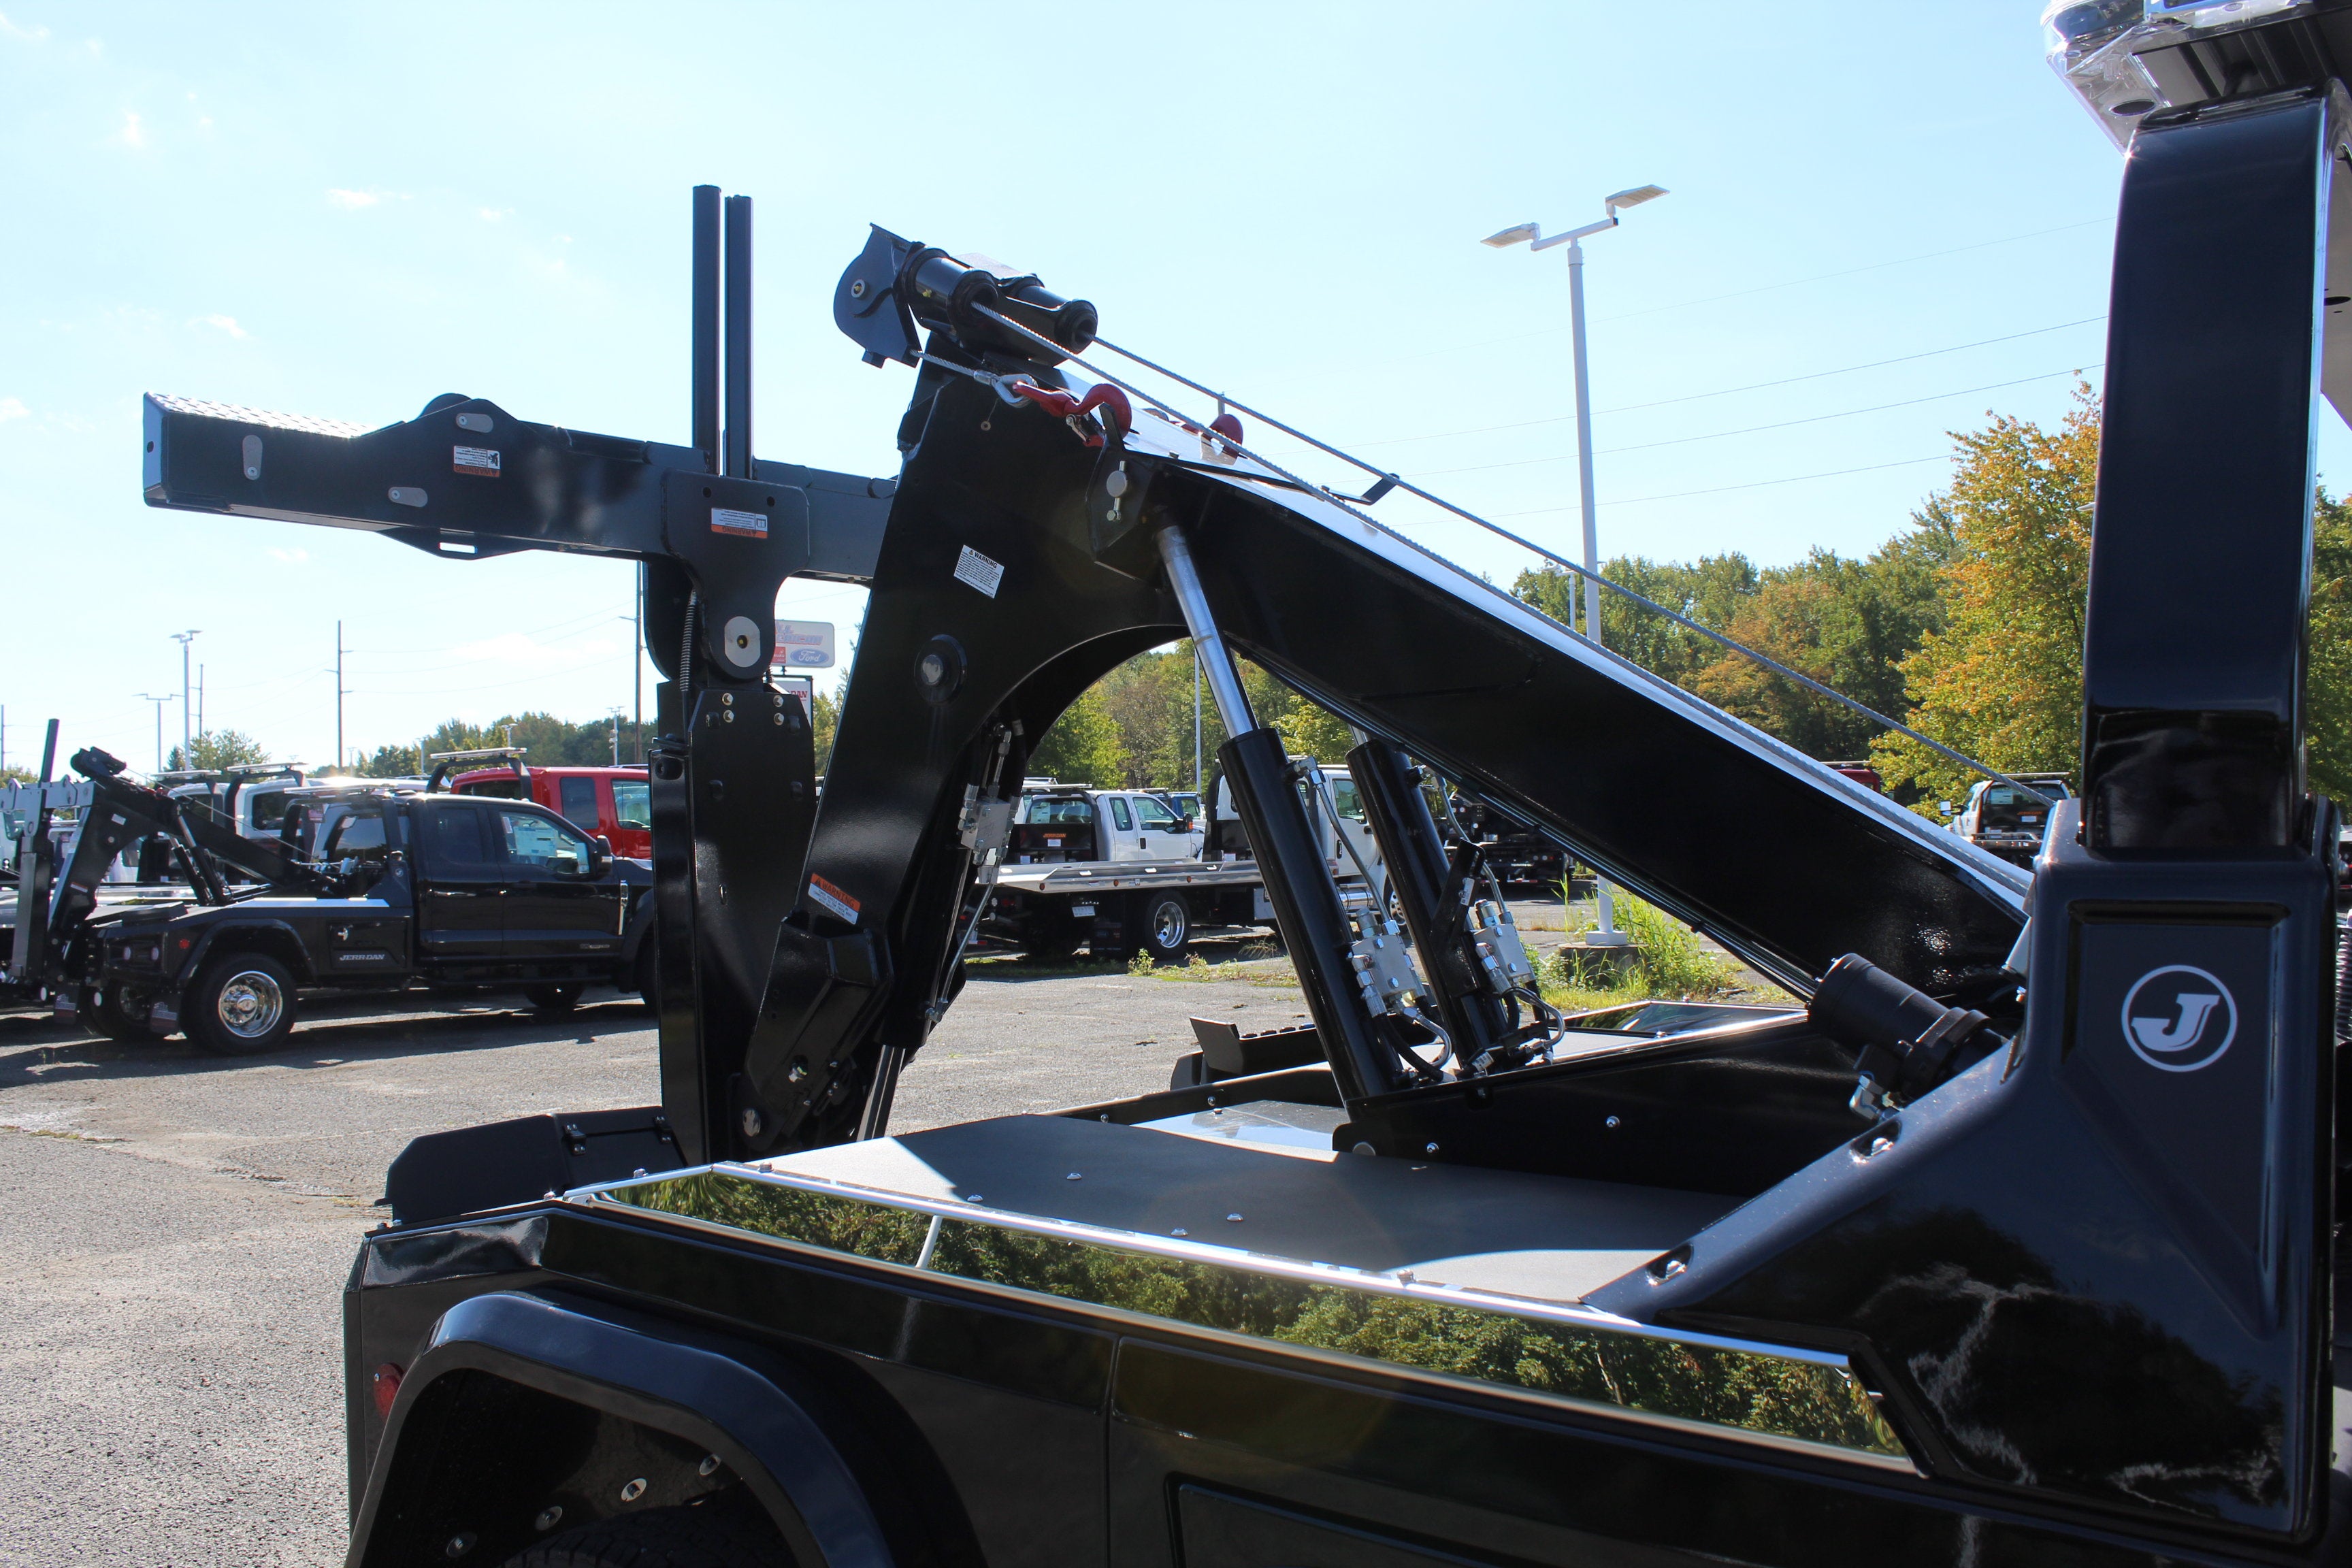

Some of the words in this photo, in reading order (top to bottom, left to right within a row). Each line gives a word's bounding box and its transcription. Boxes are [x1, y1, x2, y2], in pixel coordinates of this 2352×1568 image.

[455, 466, 492, 475] WARNING
[723, 527, 753, 536] WARNING
[975, 552, 998, 568] WARNING
[798, 650, 821, 662] Ford
[822, 882, 855, 906] WARNING
[2131, 993, 2220, 1052] J
